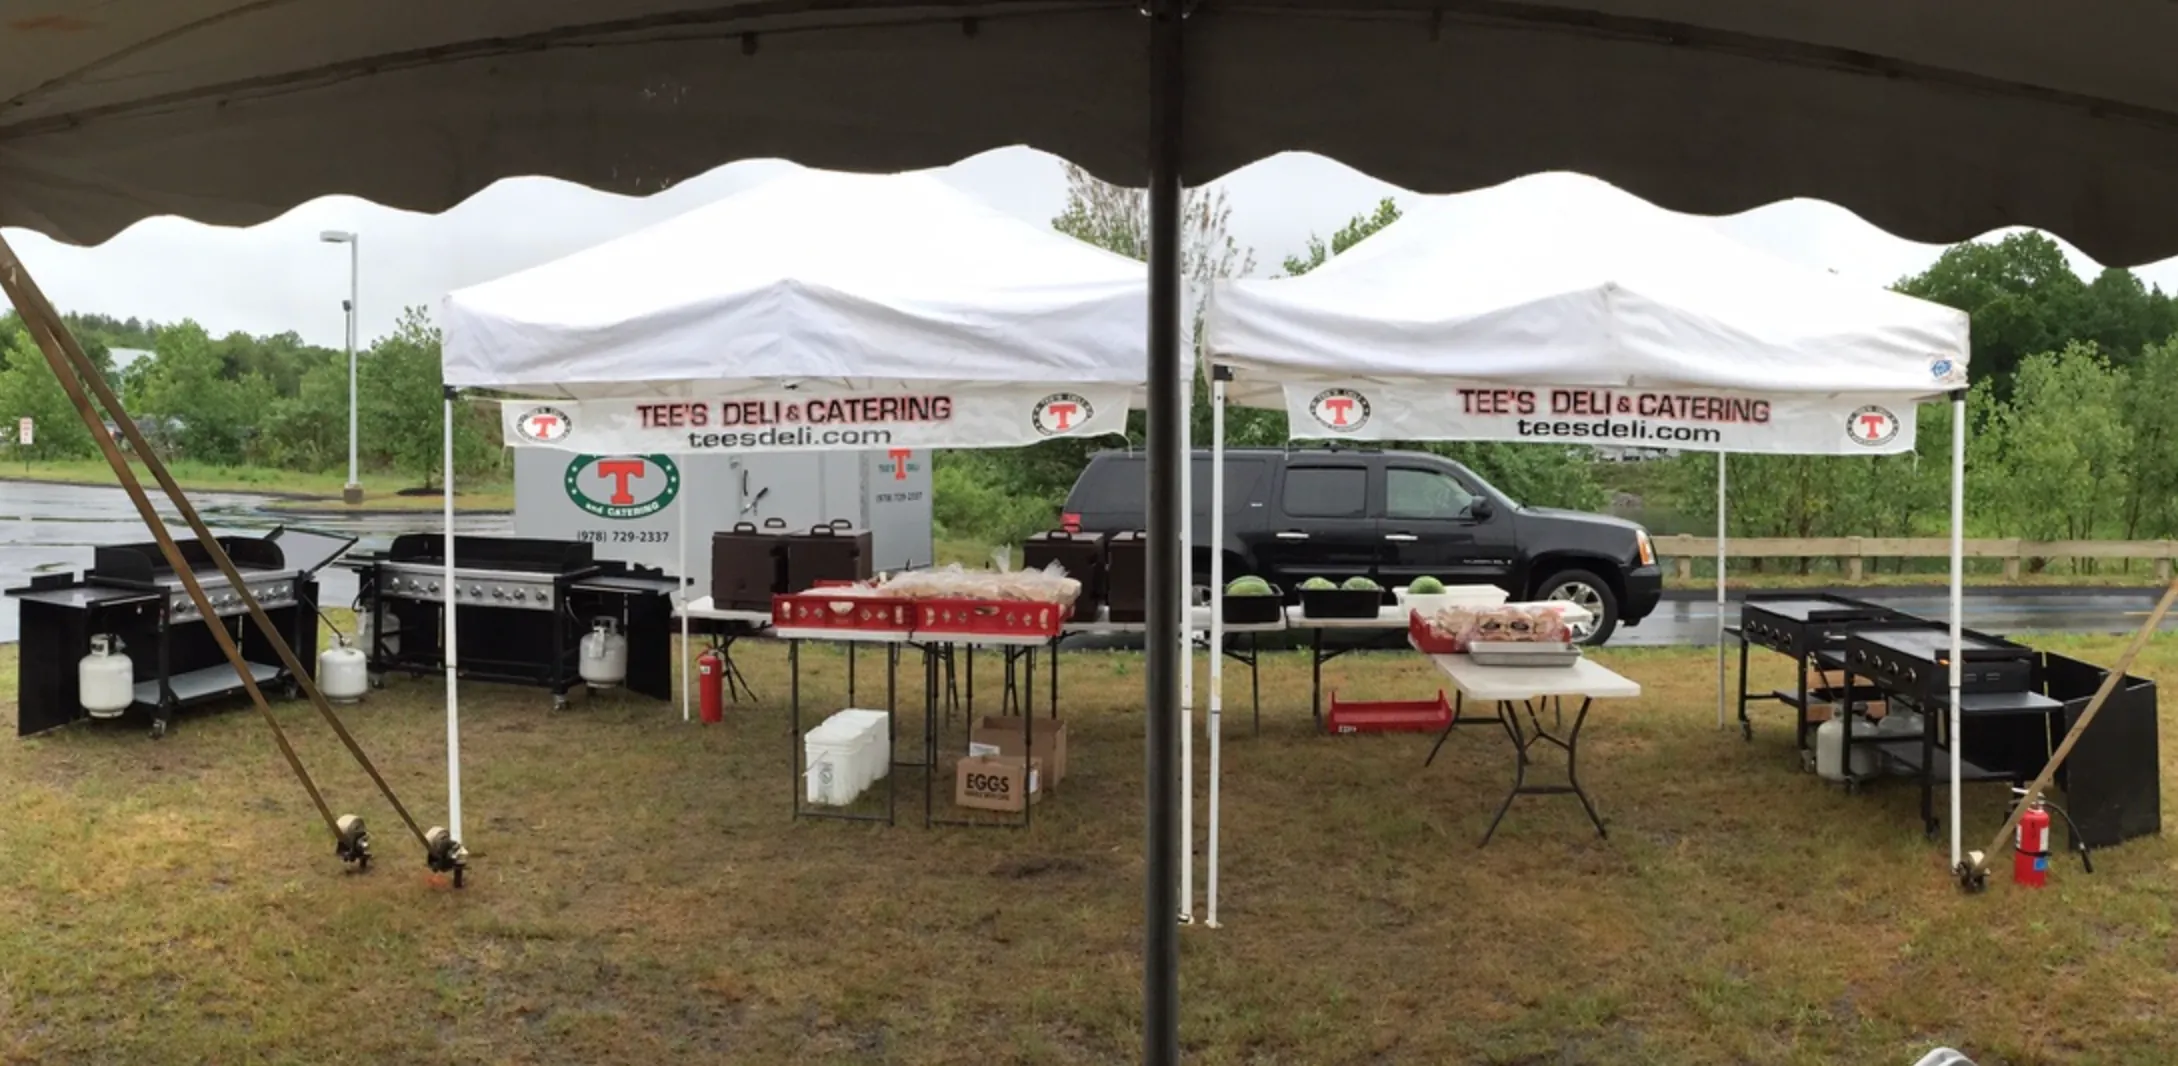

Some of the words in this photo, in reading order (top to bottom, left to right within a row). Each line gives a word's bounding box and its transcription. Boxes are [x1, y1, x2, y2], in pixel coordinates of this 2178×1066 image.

[636, 402, 709, 428] TEE'S
[722, 400, 781, 426] DELI
[785, 403, 800, 422] &
[806, 395, 952, 424] CATERING
[1457, 388, 1536, 415] TEE'S
[1551, 389, 1612, 416] DELI
[1616, 395, 1632, 414] &
[1637, 392, 1771, 424] CATERING
[688, 426, 892, 448] teesdeli.com
[1517, 417, 1721, 443] teesdeli.com
[597, 459, 645, 505] T
[607, 501, 660, 517] CATERING
[577, 530, 607, 543] (978)
[612, 530, 670, 543] 729-2337
[966, 773, 1010, 793] EGGS
